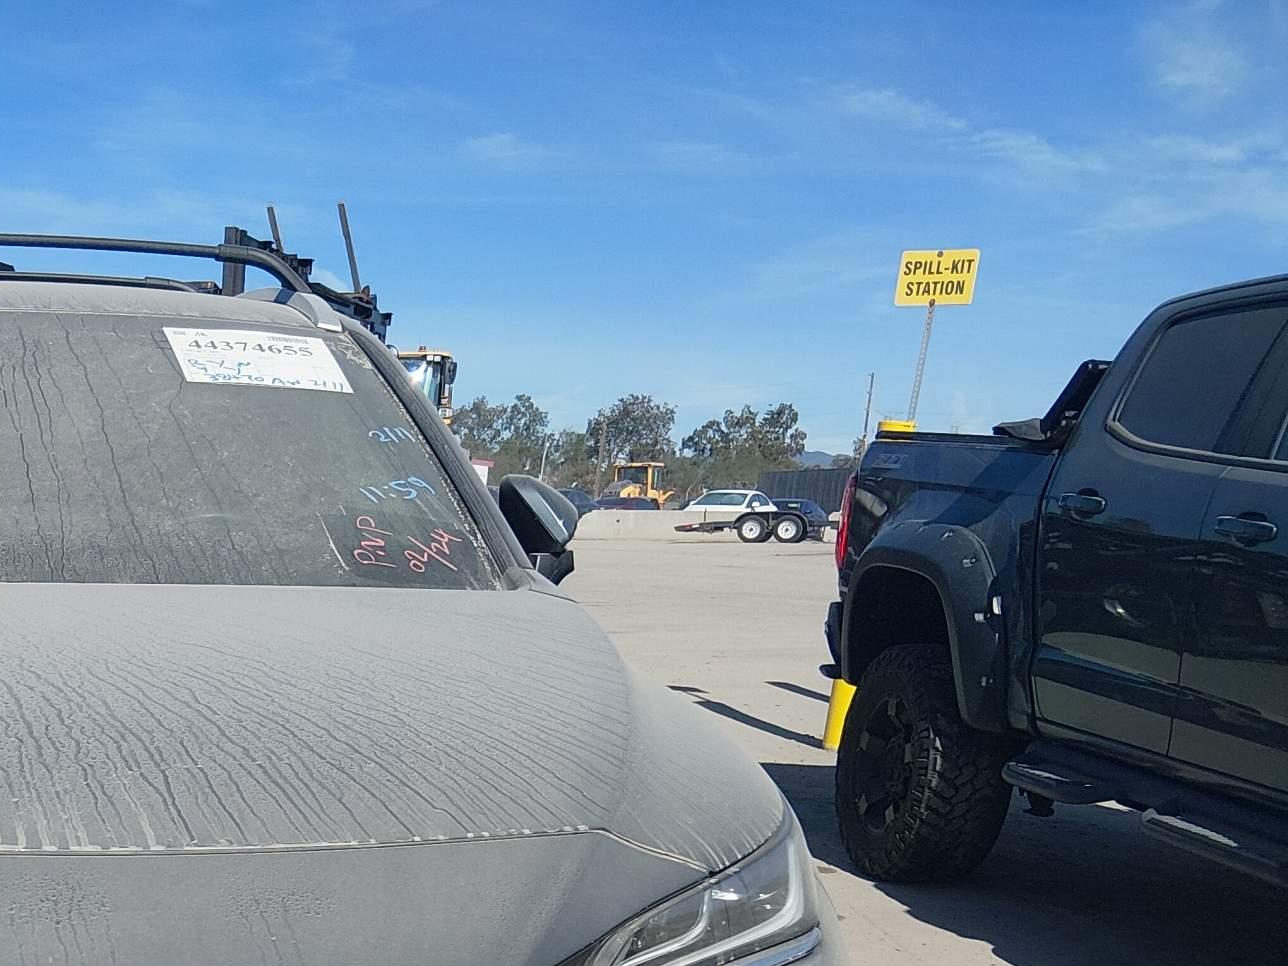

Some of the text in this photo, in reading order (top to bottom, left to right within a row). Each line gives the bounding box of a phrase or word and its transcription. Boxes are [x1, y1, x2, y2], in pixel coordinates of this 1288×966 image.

[903, 258, 976, 276] SPILL-KIT
[905, 280, 966, 297] STATION
[187, 338, 313, 357] 44374655
[359, 476, 436, 504] 11:59
[403, 528, 463, 573] 02/24
